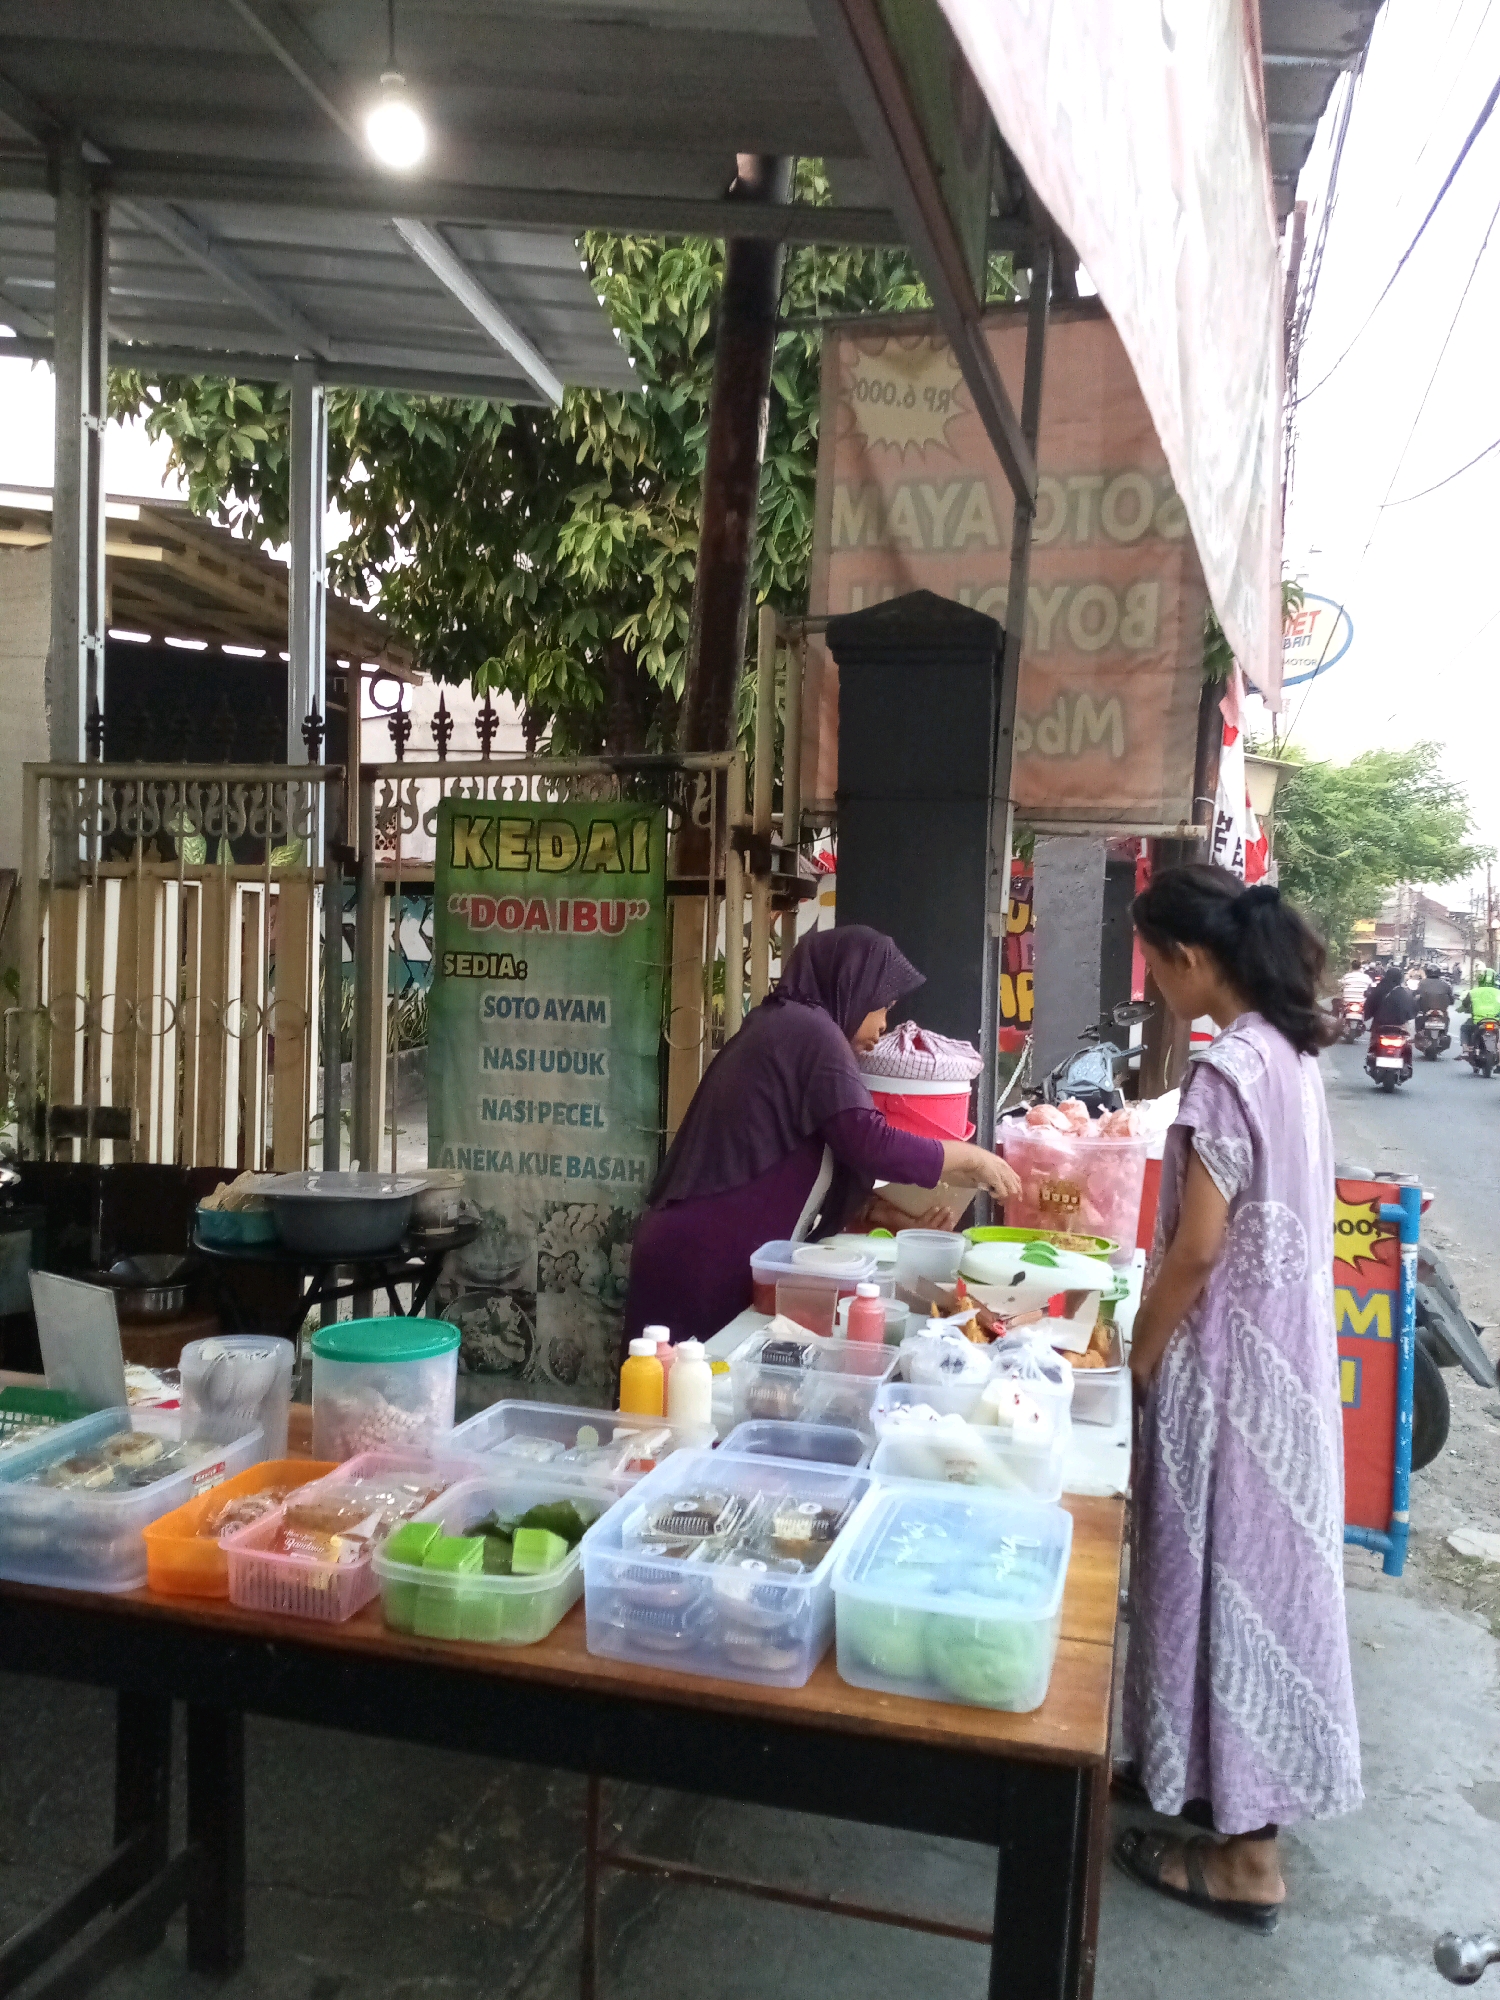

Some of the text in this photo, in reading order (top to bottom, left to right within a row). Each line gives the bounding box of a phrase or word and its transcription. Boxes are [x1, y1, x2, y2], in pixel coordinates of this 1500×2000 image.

[450, 815, 651, 874] KEDAI
[443, 952, 528, 980] SEDIA:
[483, 995, 607, 1024] SOTO AYAM
[482, 1046, 606, 1076] NASI UDUK
[481, 1098, 605, 1128] NASI PECEL
[442, 1147, 646, 1183] ANEKA KUE BASAH
